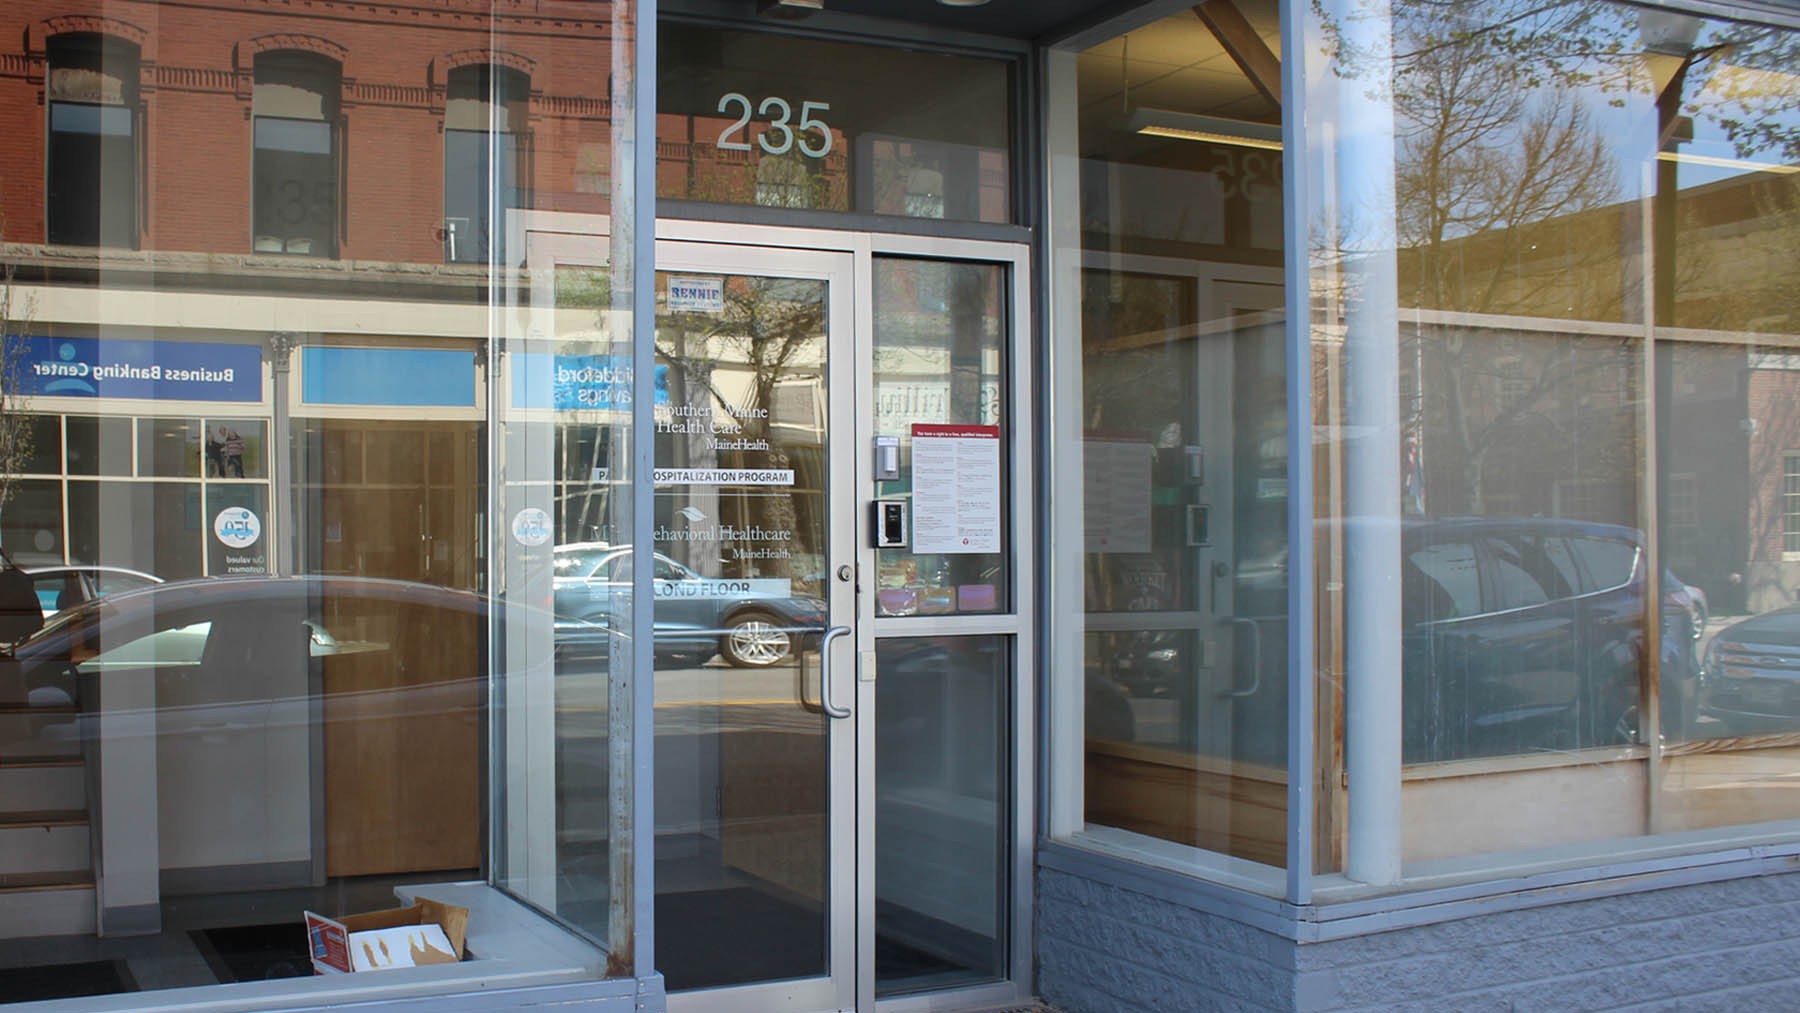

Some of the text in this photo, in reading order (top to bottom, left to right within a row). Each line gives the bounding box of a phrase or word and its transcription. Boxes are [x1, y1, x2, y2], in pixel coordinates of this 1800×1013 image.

[717, 93, 833, 159] 235
[657, 418, 743, 434] Health Care
[705, 437, 769, 451] MaineHealth
[653, 471, 788, 482] OSPITALIZATION PROGRAM
[653, 525, 791, 541] ehavioral Healthcare
[732, 548, 791, 560] MaineHealth
[701, 582, 751, 597] FLOOR
